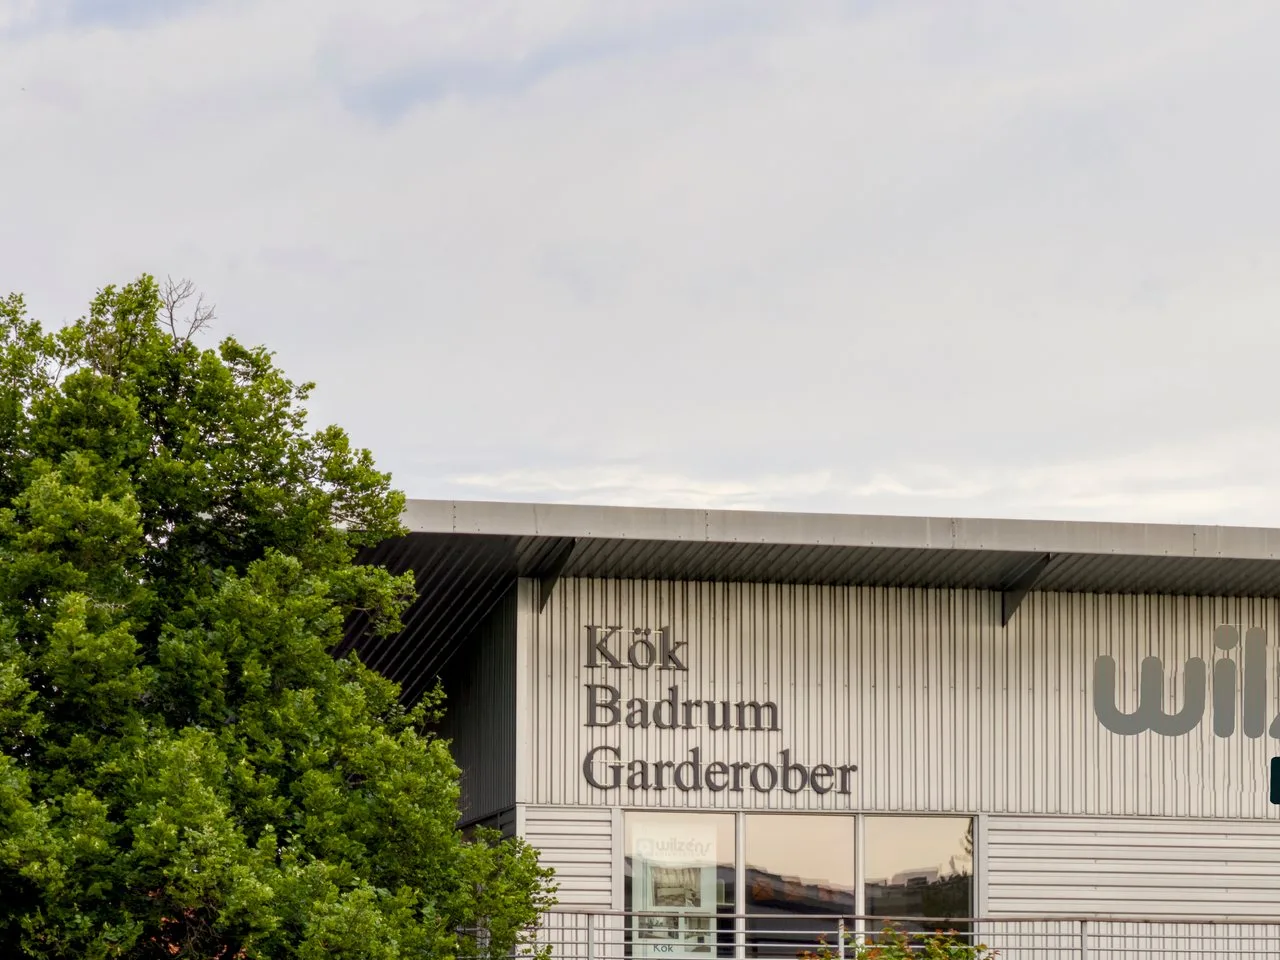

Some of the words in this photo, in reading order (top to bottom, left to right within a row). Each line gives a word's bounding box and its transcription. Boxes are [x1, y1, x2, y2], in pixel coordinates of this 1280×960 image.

[584, 625, 689, 671] Kök
[584, 684, 782, 731] Badrum
[583, 746, 858, 795] Garderober
